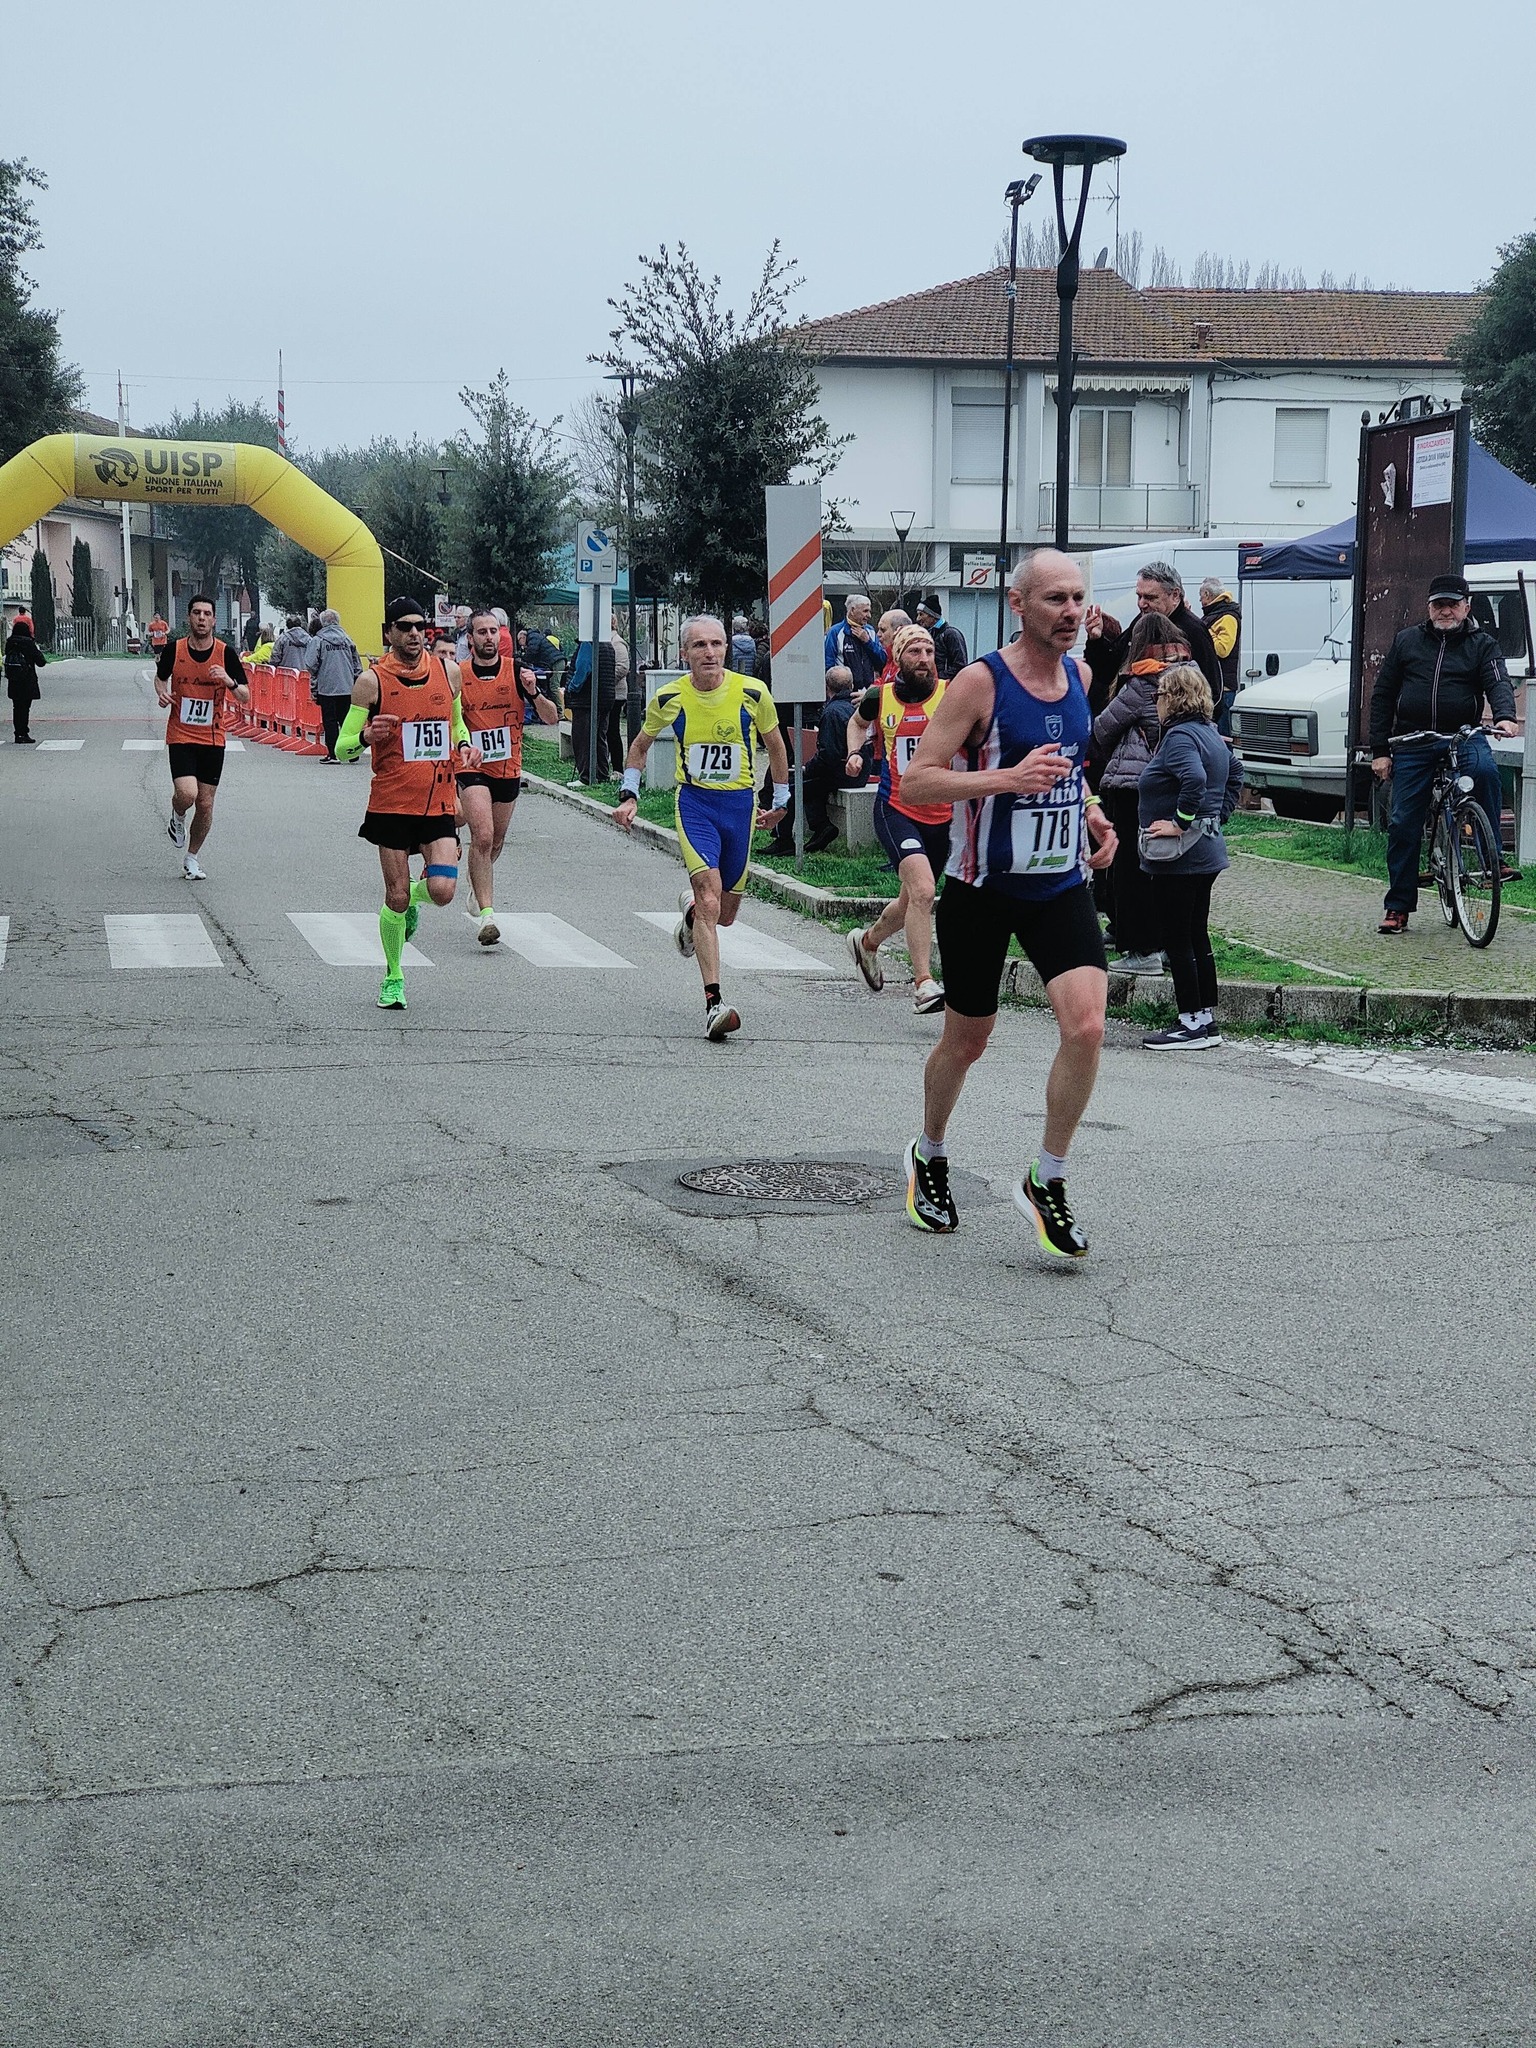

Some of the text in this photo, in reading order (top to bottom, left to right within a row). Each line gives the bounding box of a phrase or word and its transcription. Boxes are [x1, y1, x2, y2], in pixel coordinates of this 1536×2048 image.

[144, 449, 223, 477] UISP
[145, 476, 223, 488] UNIONE ITALIANA
[145, 485, 219, 496] SPORT PER TUTTI
[189, 699, 210, 717] 737
[413, 723, 443, 748] 755
[481, 729, 505, 751] 614
[700, 744, 732, 770] 723
[1031, 808, 1070, 852] 778
